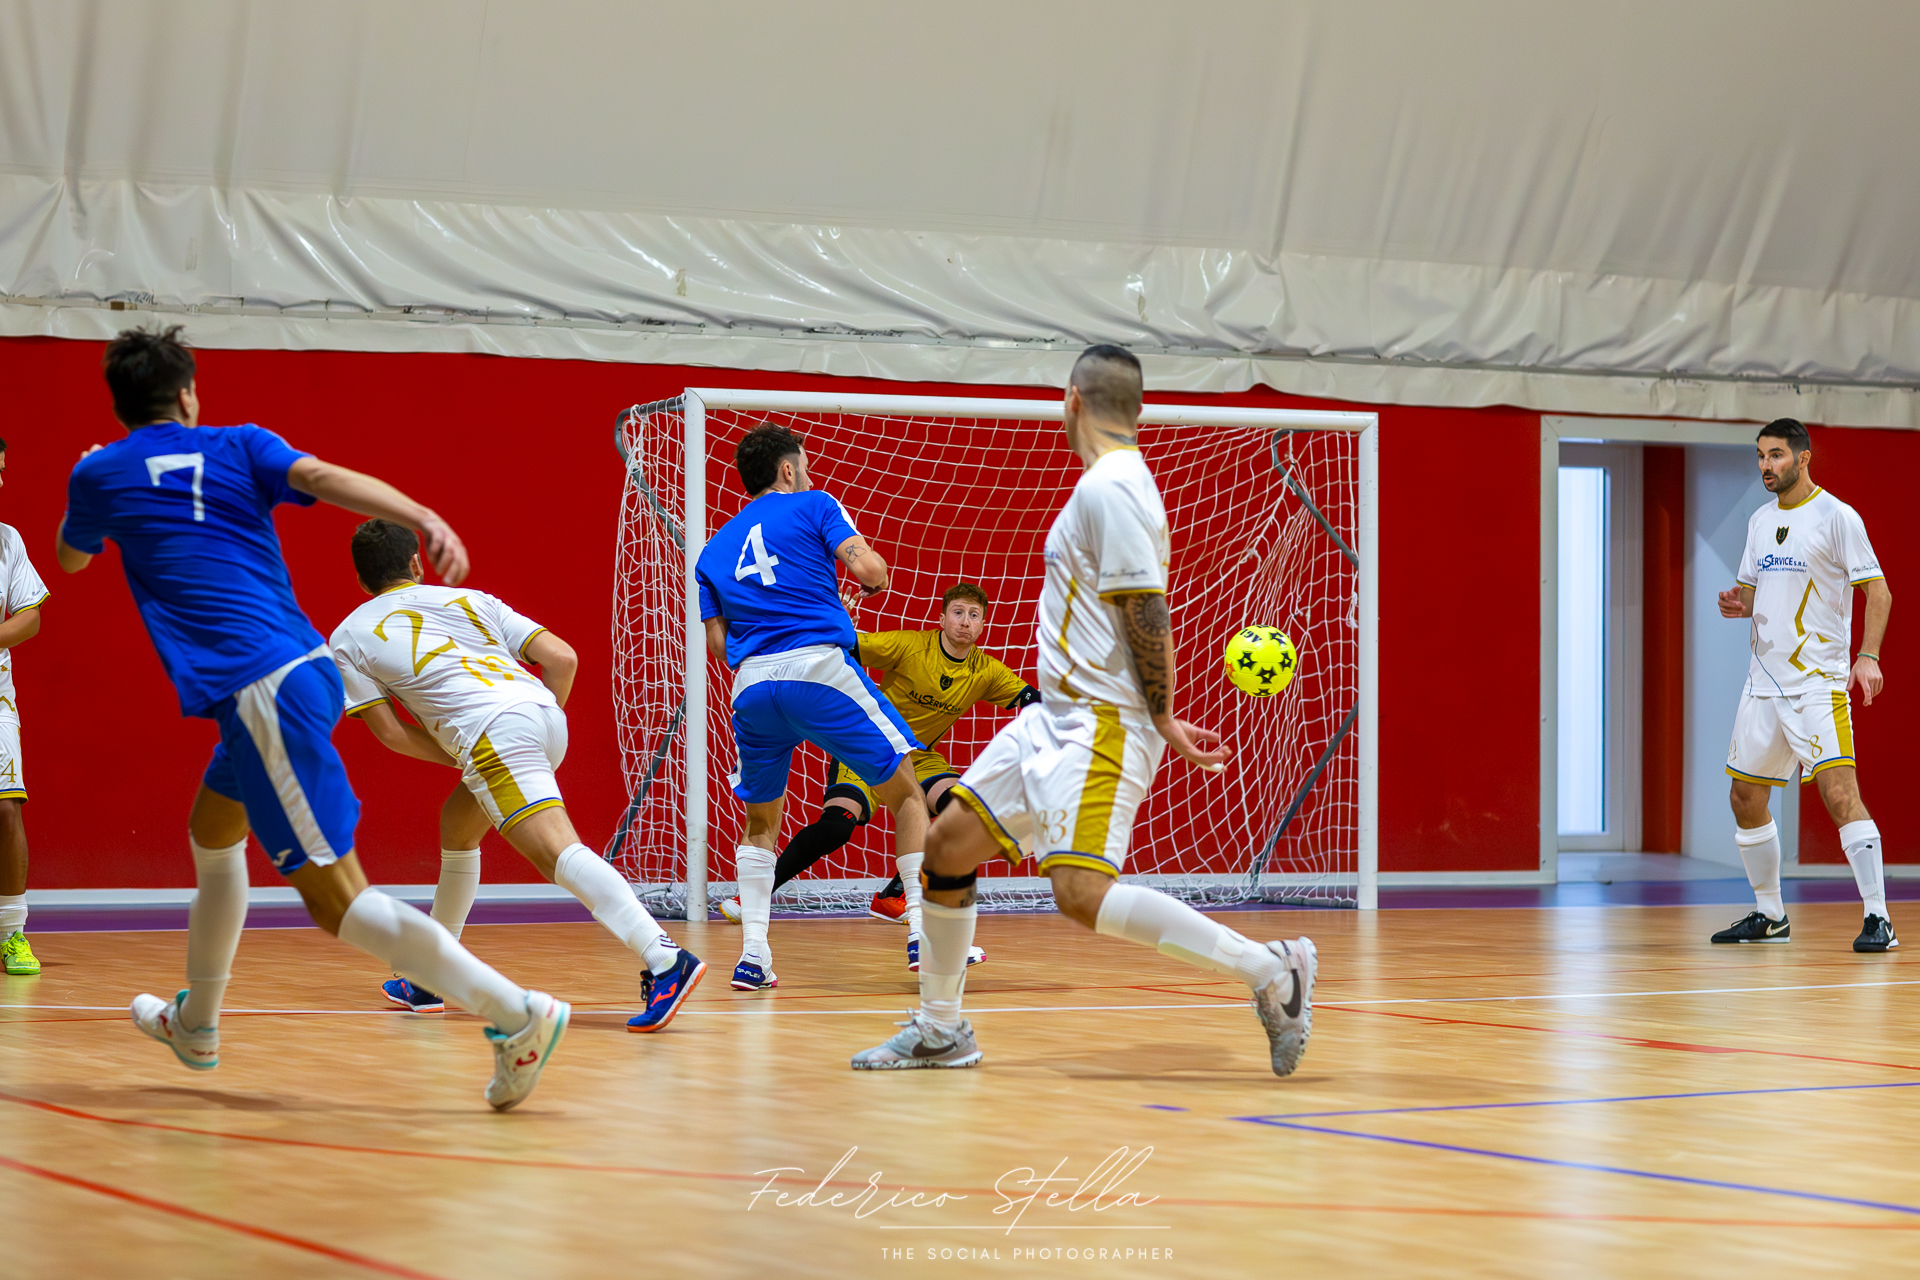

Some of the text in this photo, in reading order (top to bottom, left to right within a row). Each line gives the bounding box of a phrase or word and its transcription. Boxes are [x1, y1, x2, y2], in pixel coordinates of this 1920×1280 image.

[145, 452, 205, 522] 7
[735, 523, 779, 586] 4
[373, 596, 500, 677] 21
[1, 758, 17, 783] 4
[1809, 735, 1823, 759] 8
